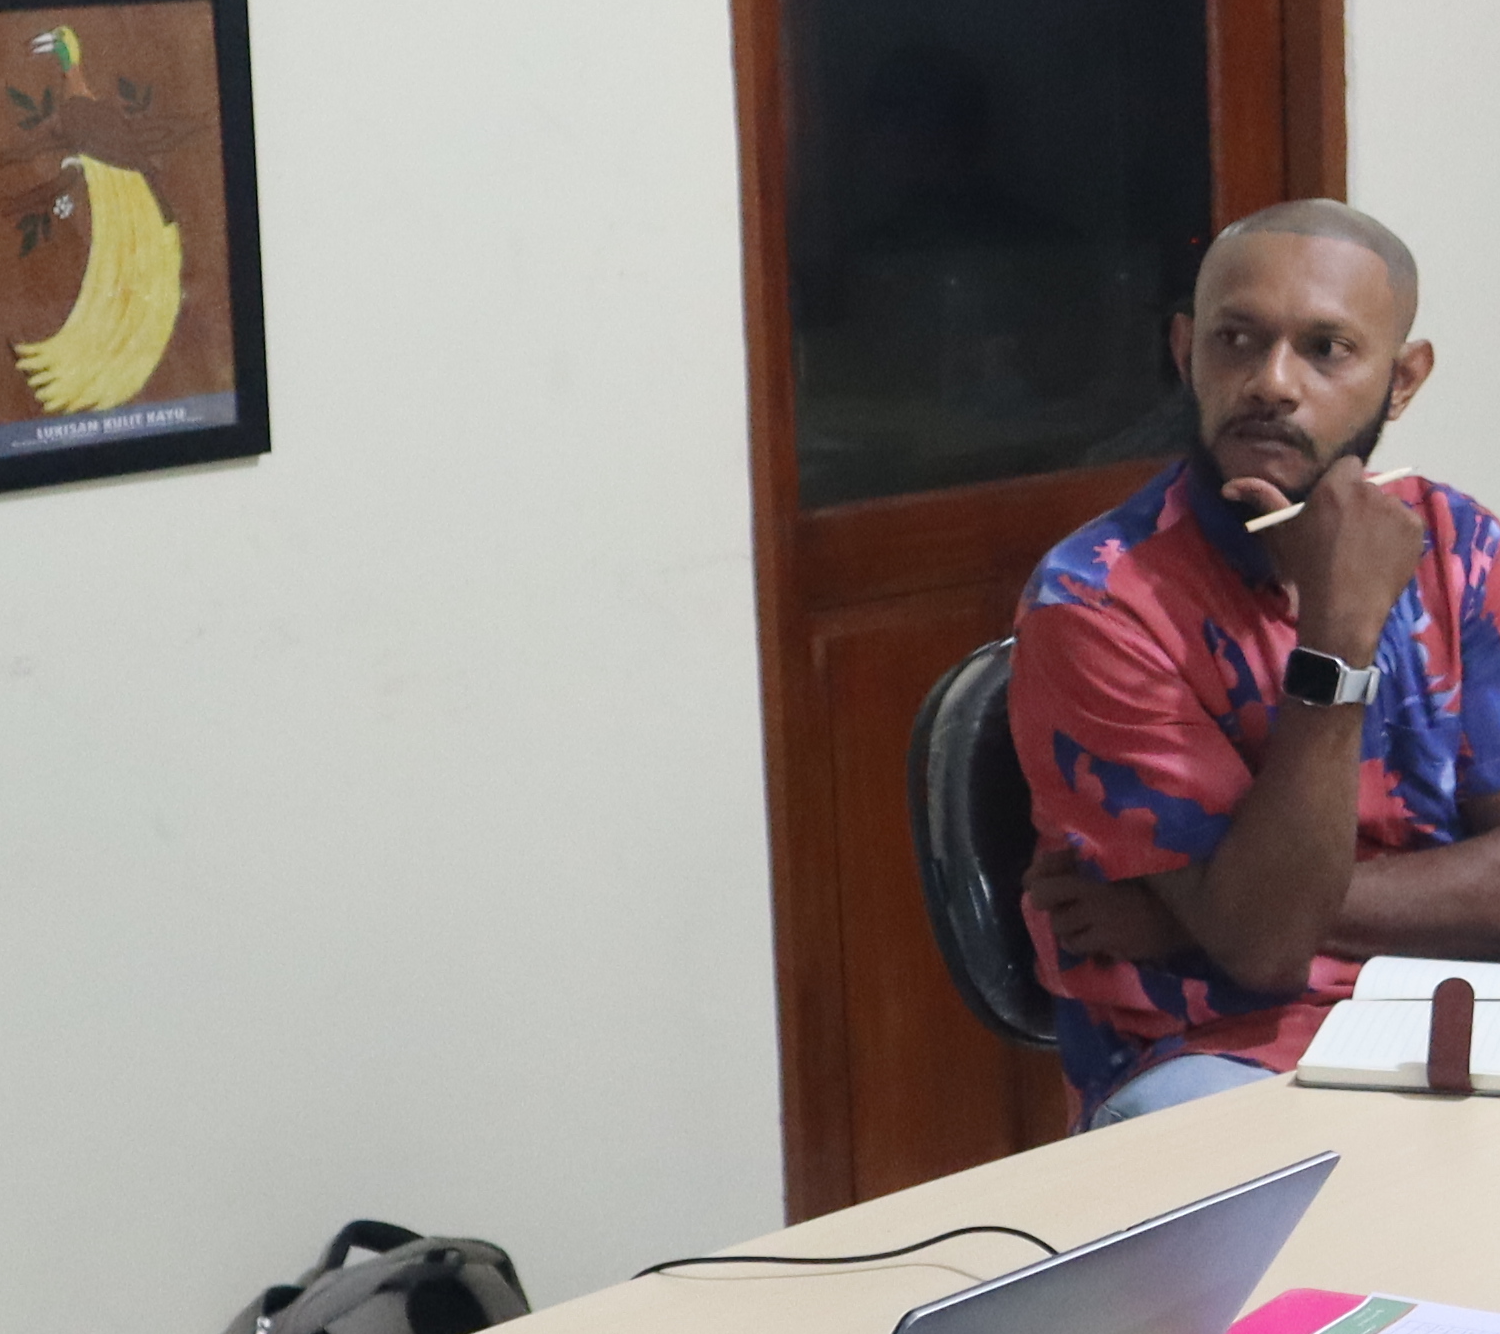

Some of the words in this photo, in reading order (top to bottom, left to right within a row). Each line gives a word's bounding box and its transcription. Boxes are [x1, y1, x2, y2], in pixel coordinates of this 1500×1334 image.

[36, 420, 98, 440] LUKISAN
[103, 413, 143, 433] KULIT
[147, 407, 186, 427] KAYU
